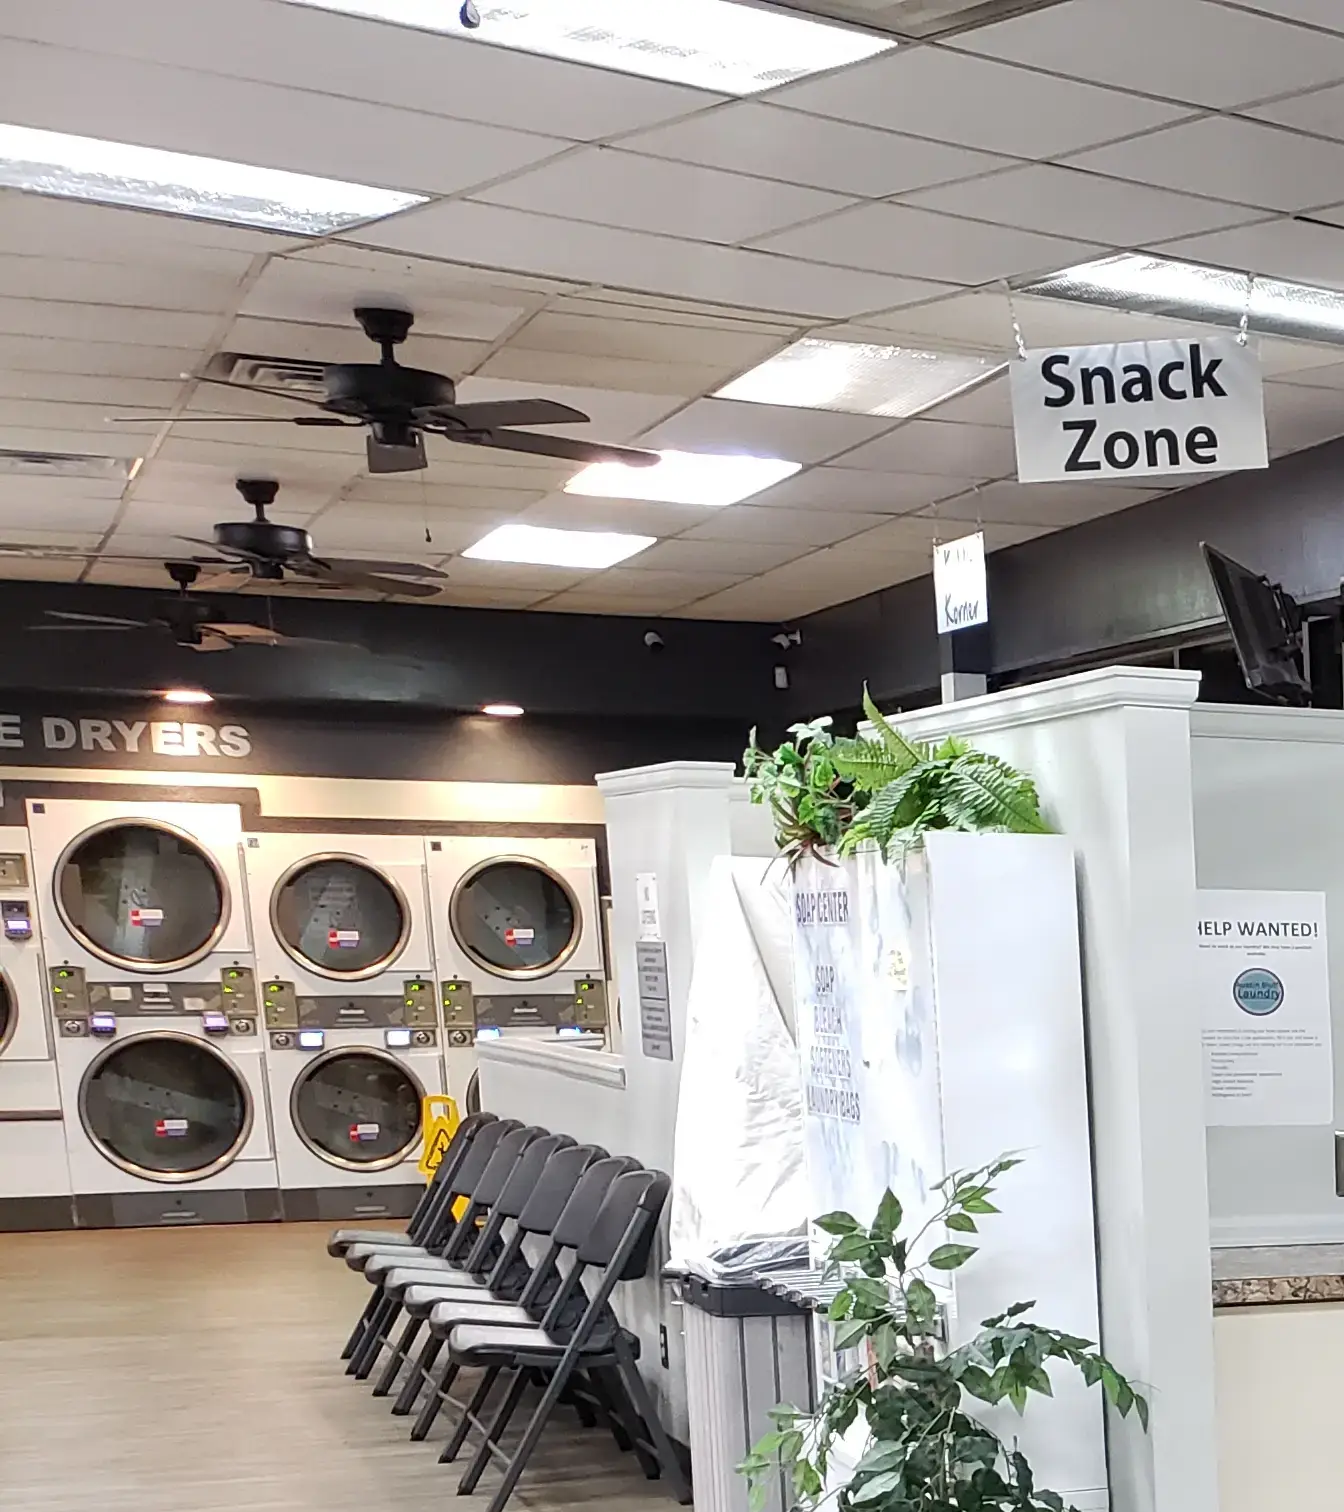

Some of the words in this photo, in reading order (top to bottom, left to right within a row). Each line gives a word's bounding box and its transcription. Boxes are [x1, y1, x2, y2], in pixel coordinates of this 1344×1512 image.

[1041, 343, 1228, 408] Snack
[1062, 419, 1218, 472] Zone
[41, 716, 252, 758] DRYERS
[796, 891, 816, 924] SOAP
[817, 891, 849, 924] CENTER
[1237, 921, 1318, 938] WANTED!
[816, 965, 835, 993] SOAP
[1238, 989, 1280, 1001] Laundry
